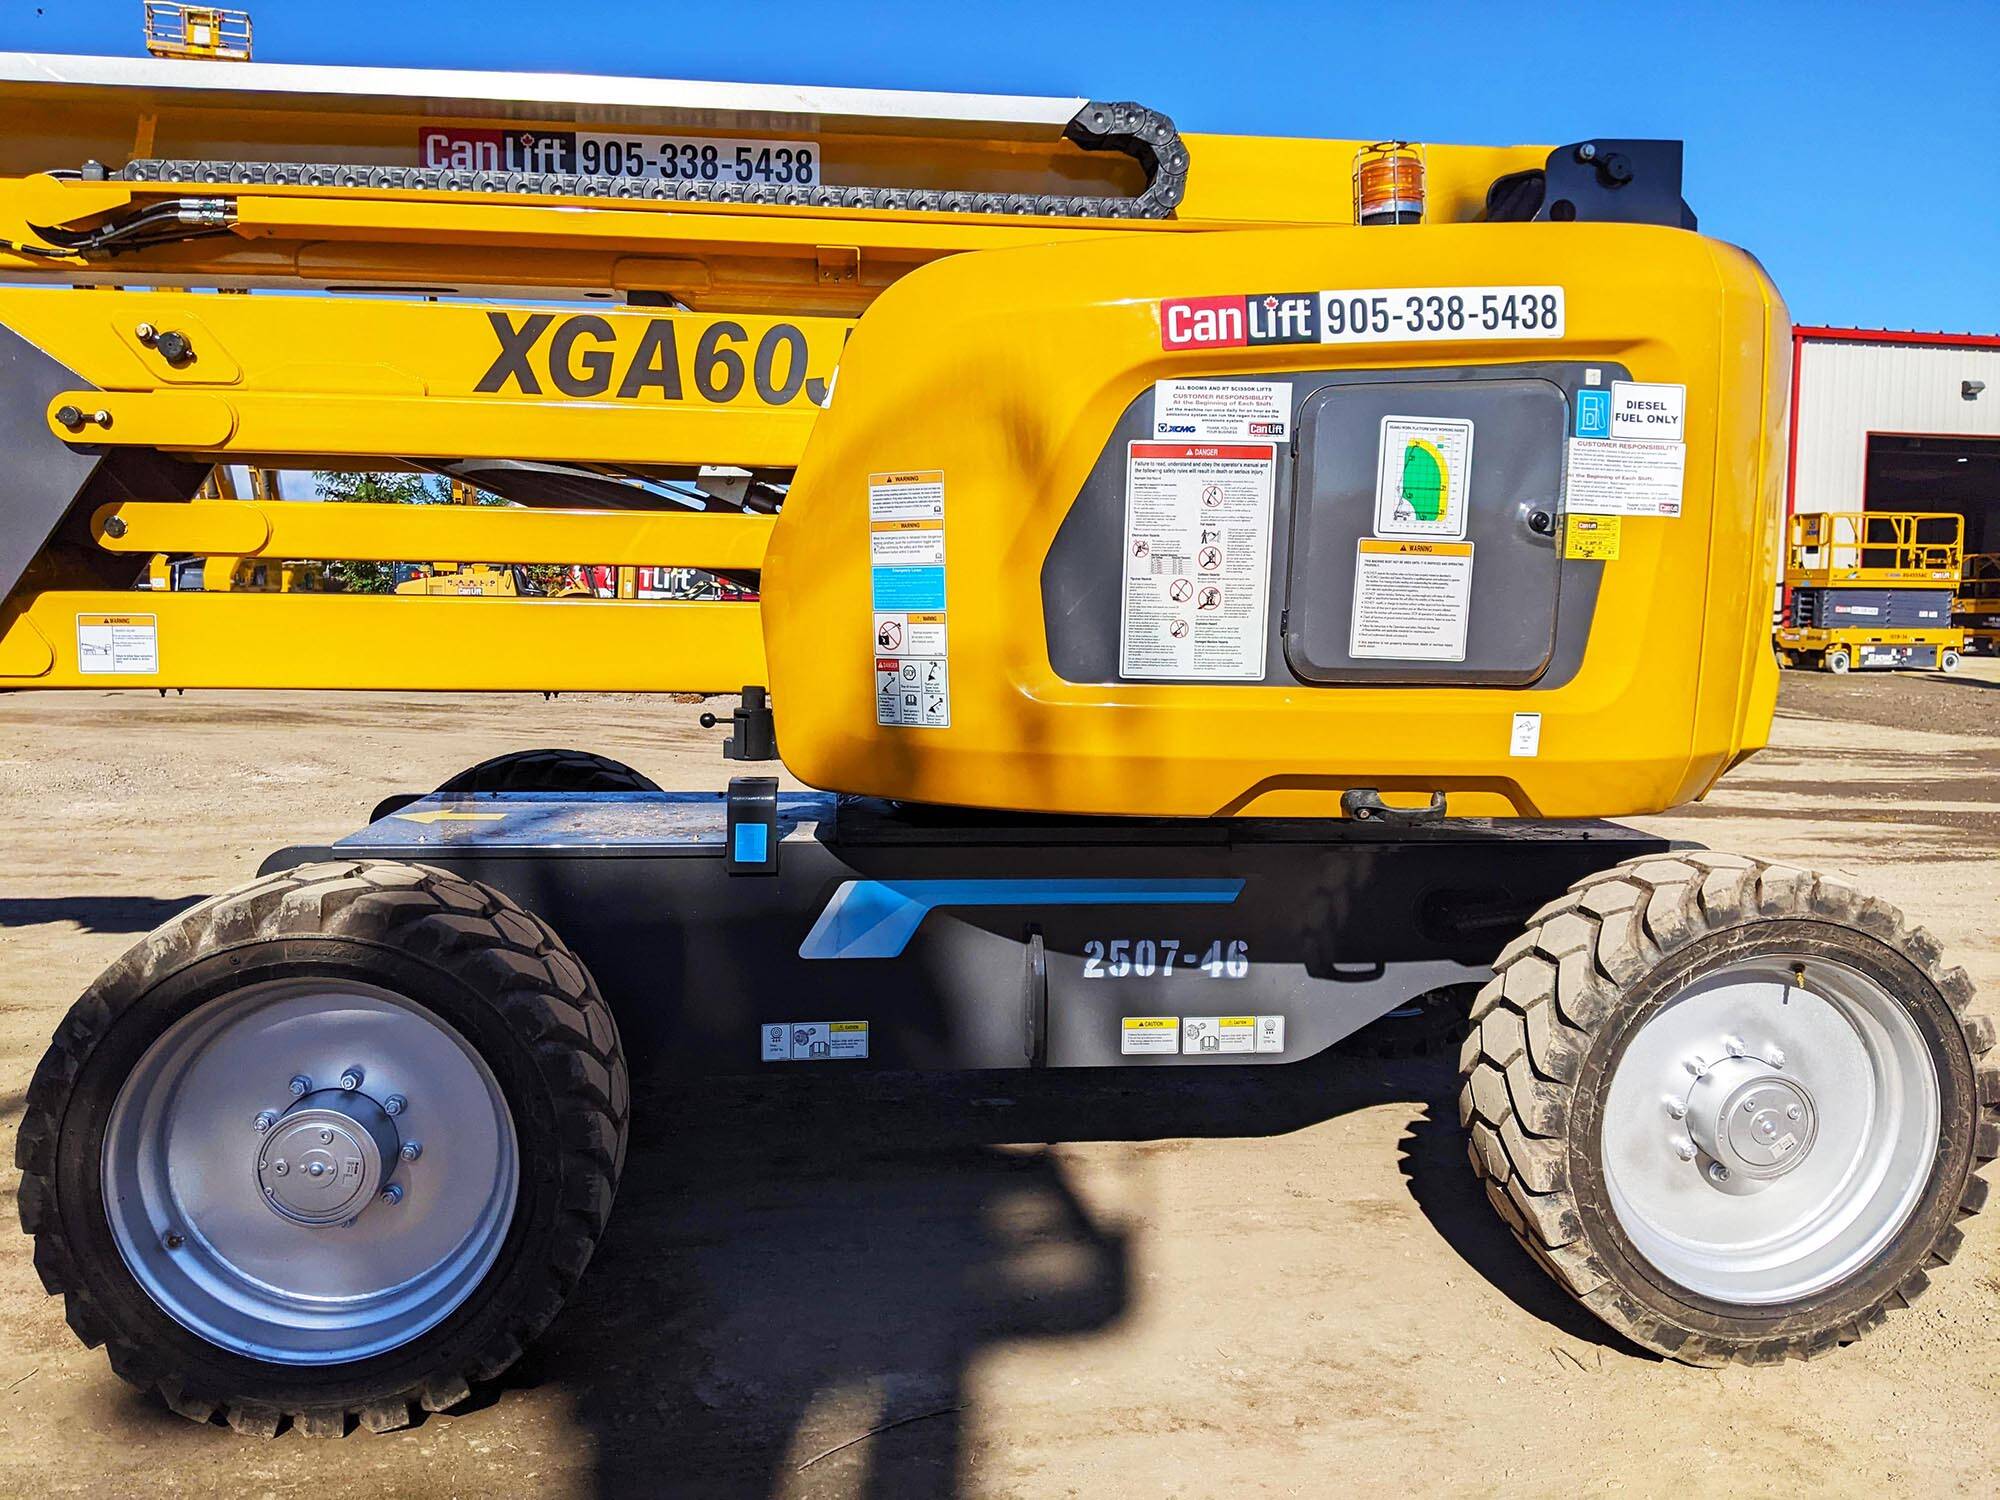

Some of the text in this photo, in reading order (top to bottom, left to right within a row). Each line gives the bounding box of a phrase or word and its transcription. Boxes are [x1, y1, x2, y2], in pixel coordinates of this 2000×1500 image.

[582, 139, 813, 185] 905-338-5438
[1327, 294, 1558, 335] 905-338-5438
[1627, 400, 1667, 410] DIESEL
[1616, 413, 1678, 424] FUEL ONLY
[1168, 425, 1196, 433] XCMG
[1195, 448, 1218, 456] DANGER
[1620, 443, 1678, 451] RESPONSIBILITY
[1084, 940, 1248, 978] 2507-46
